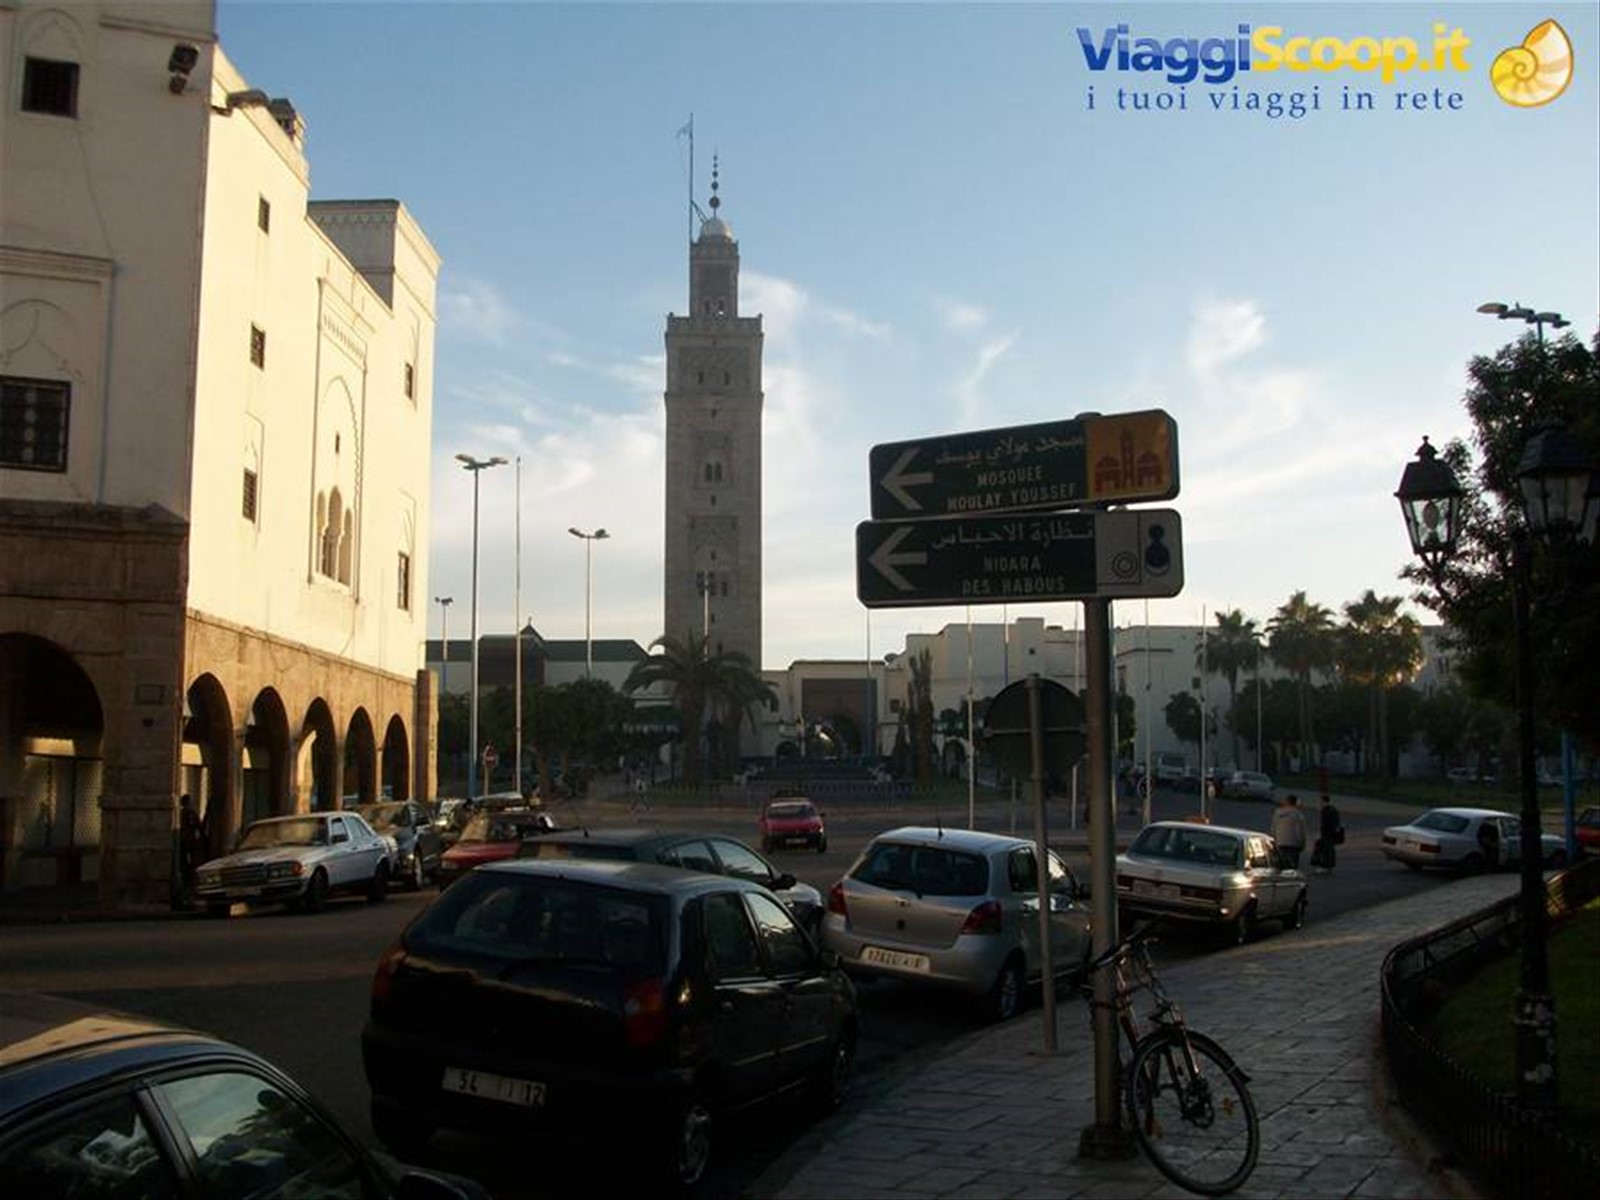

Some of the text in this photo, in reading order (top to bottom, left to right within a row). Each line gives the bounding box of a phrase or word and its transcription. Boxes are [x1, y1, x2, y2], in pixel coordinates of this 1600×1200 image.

[946, 482, 1078, 512] MOULAY YOUSSEF
[961, 576, 1066, 595] DES HABOUS
